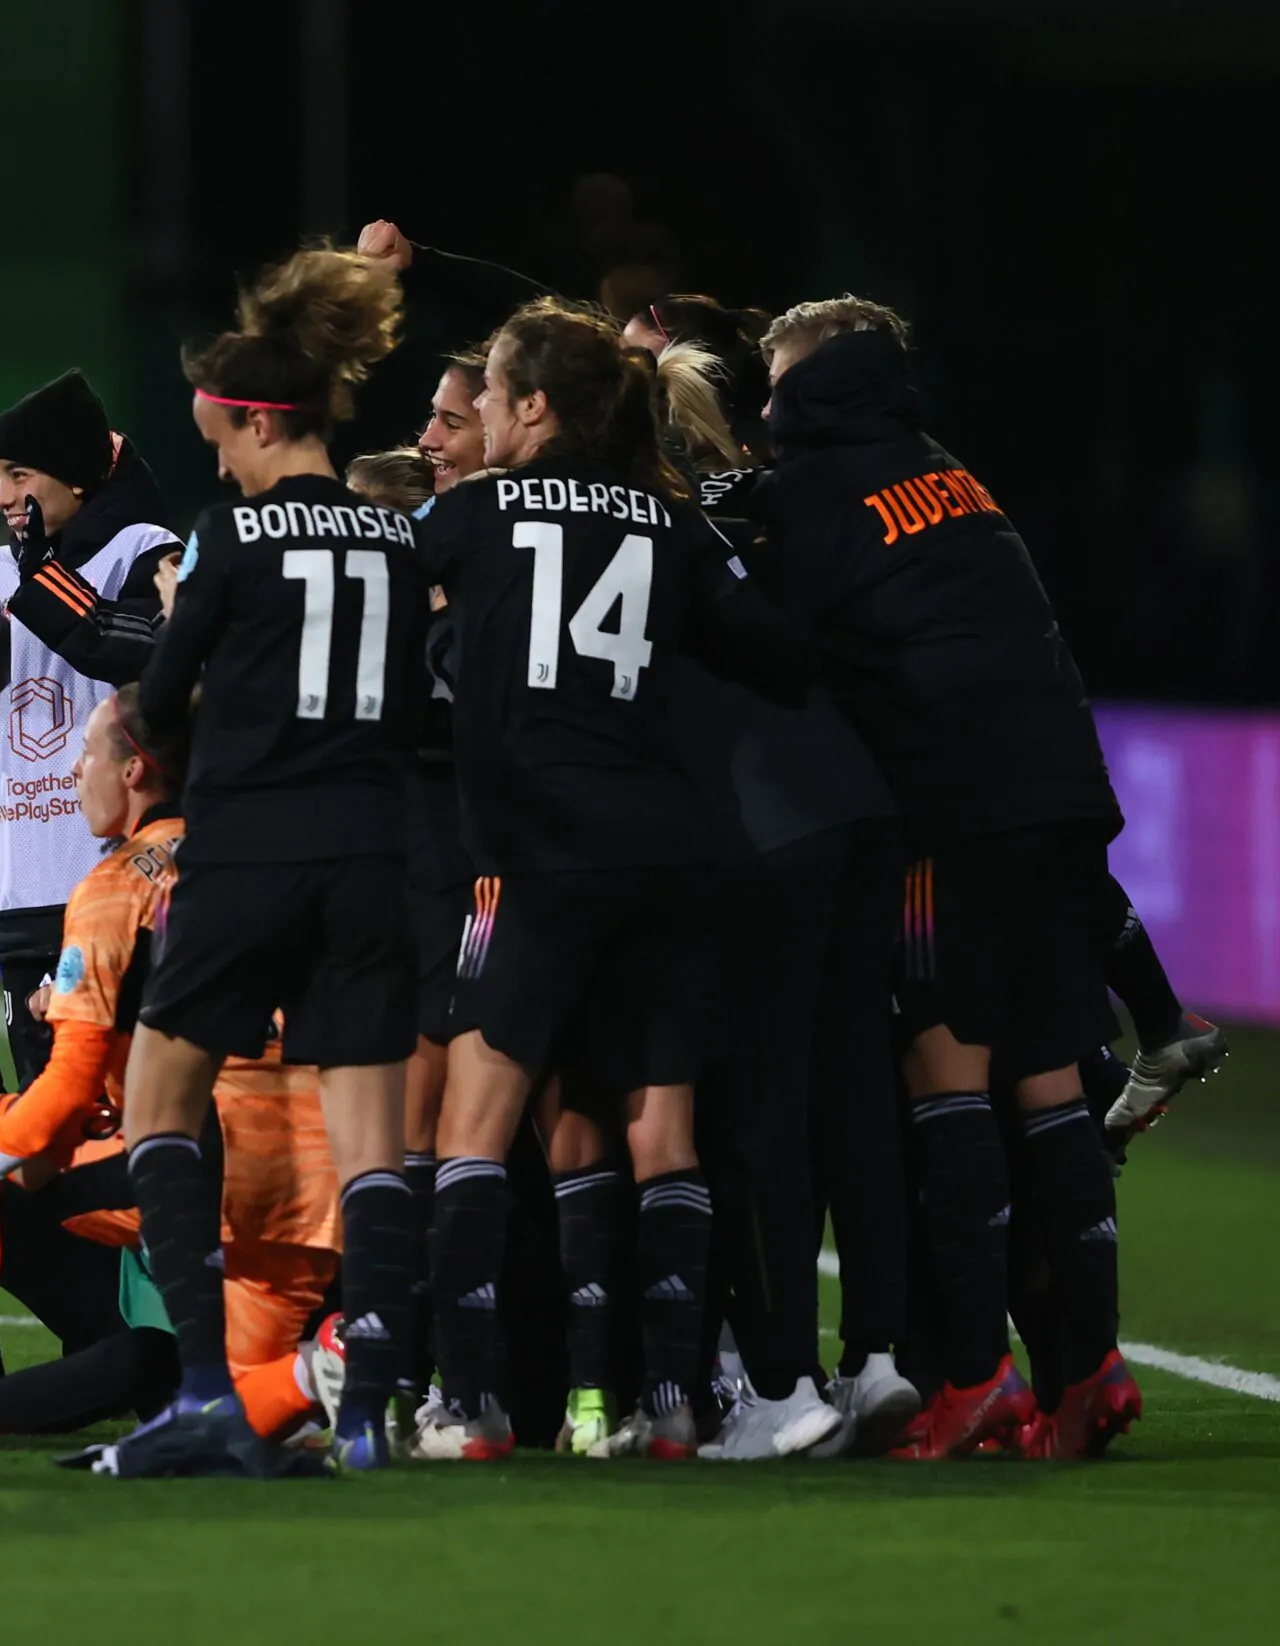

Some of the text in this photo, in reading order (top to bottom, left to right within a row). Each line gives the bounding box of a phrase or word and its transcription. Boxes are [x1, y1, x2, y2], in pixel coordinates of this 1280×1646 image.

[233, 501, 416, 549] BONANSEA
[496, 478, 672, 528] PEDERSEN
[282, 549, 390, 720] 11
[512, 521, 654, 701] 14
